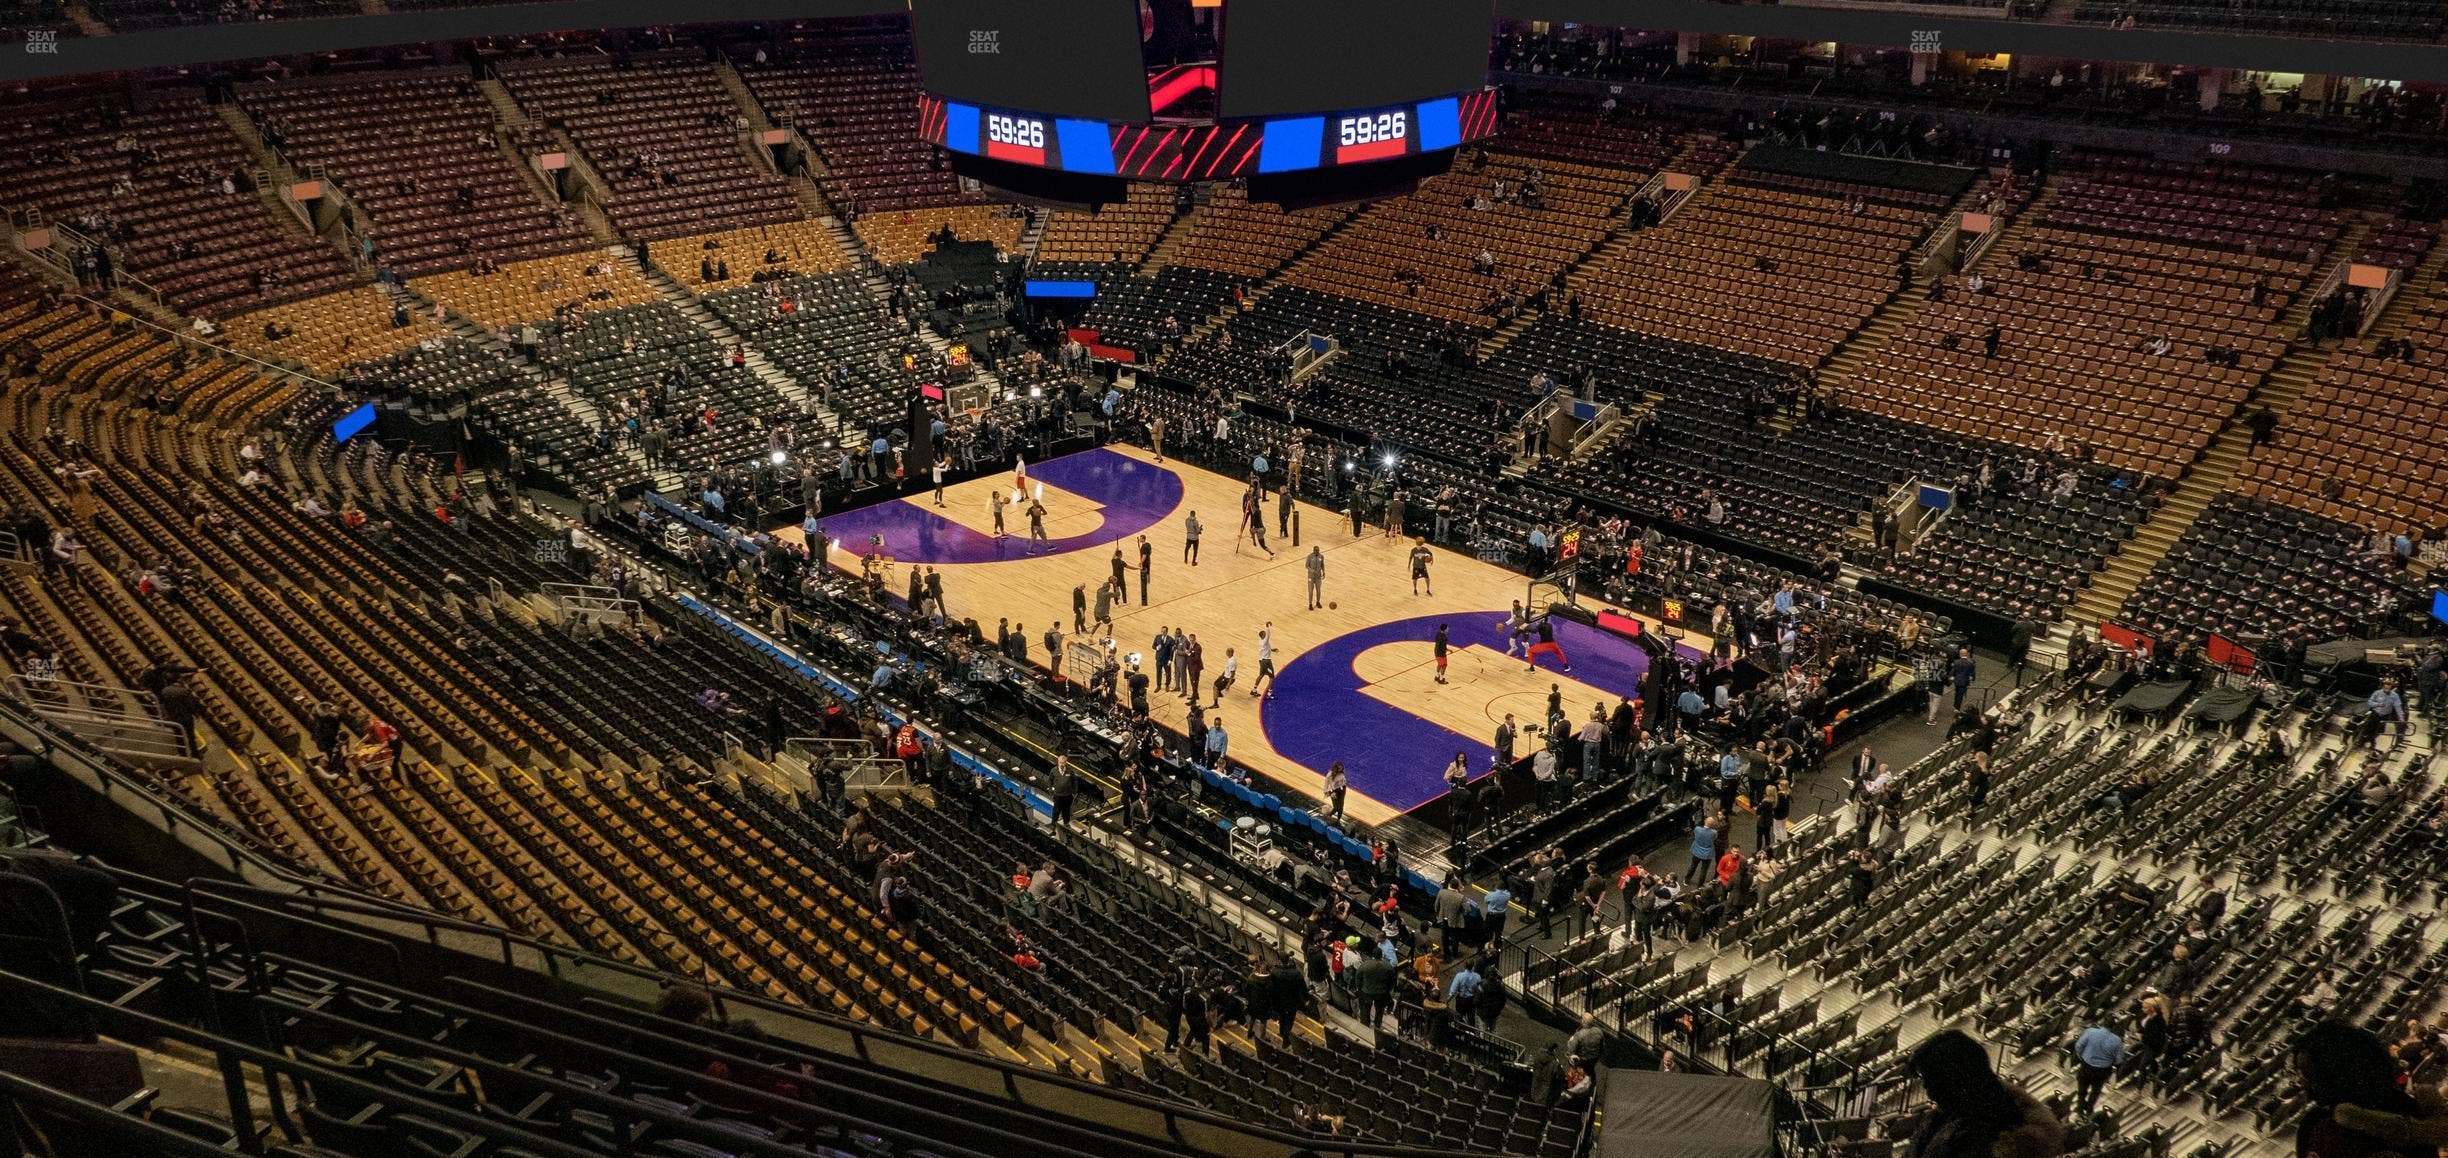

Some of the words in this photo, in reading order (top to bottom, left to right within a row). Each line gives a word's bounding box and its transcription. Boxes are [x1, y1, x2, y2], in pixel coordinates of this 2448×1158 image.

[1610, 85, 1623, 94] 107
[989, 114, 1044, 148] 59:26
[1341, 112, 1406, 146] 59:26
[2210, 143, 2230, 154] 109
[1563, 542, 1578, 559] 24
